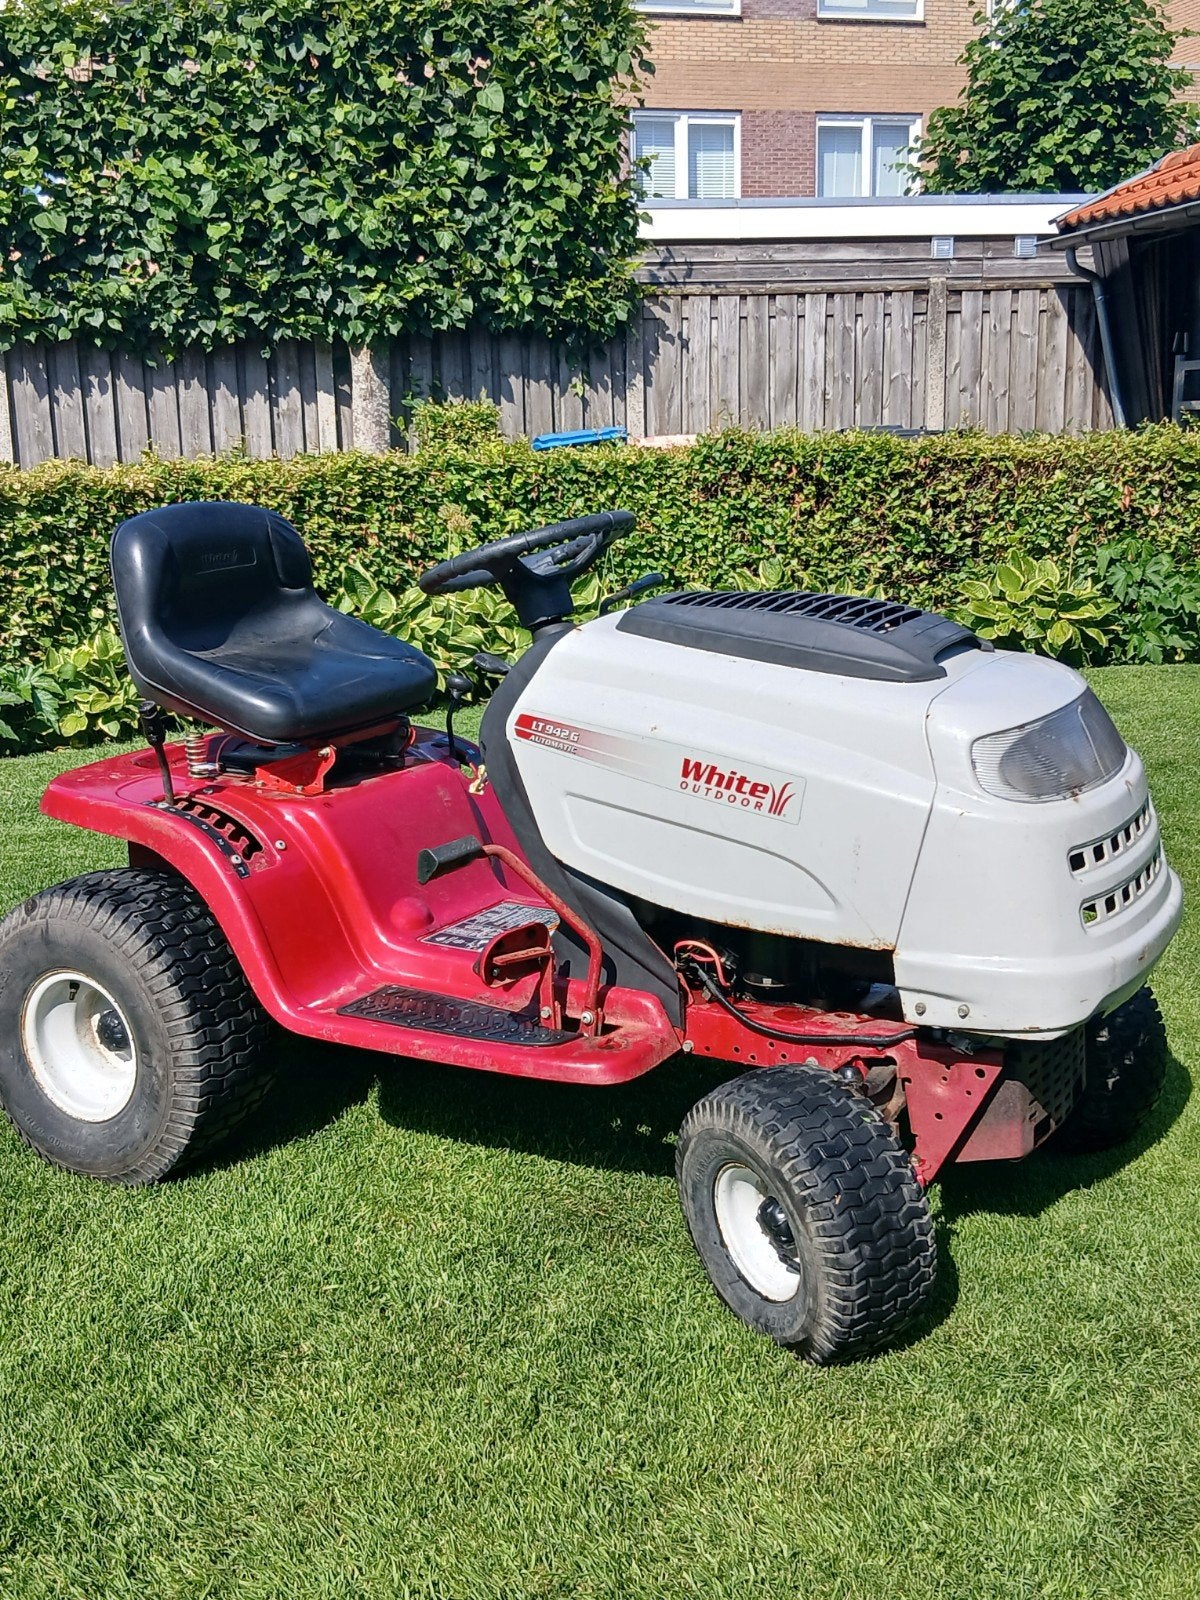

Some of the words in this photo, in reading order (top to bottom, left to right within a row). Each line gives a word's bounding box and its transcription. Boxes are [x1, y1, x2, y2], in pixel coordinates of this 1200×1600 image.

[531, 720, 546, 732] LT
[545, 724, 570, 740] 942
[529, 734, 577, 755] AUTOMATIC
[681, 757, 770, 800] White
[680, 780, 764, 812] OUTDOOR
